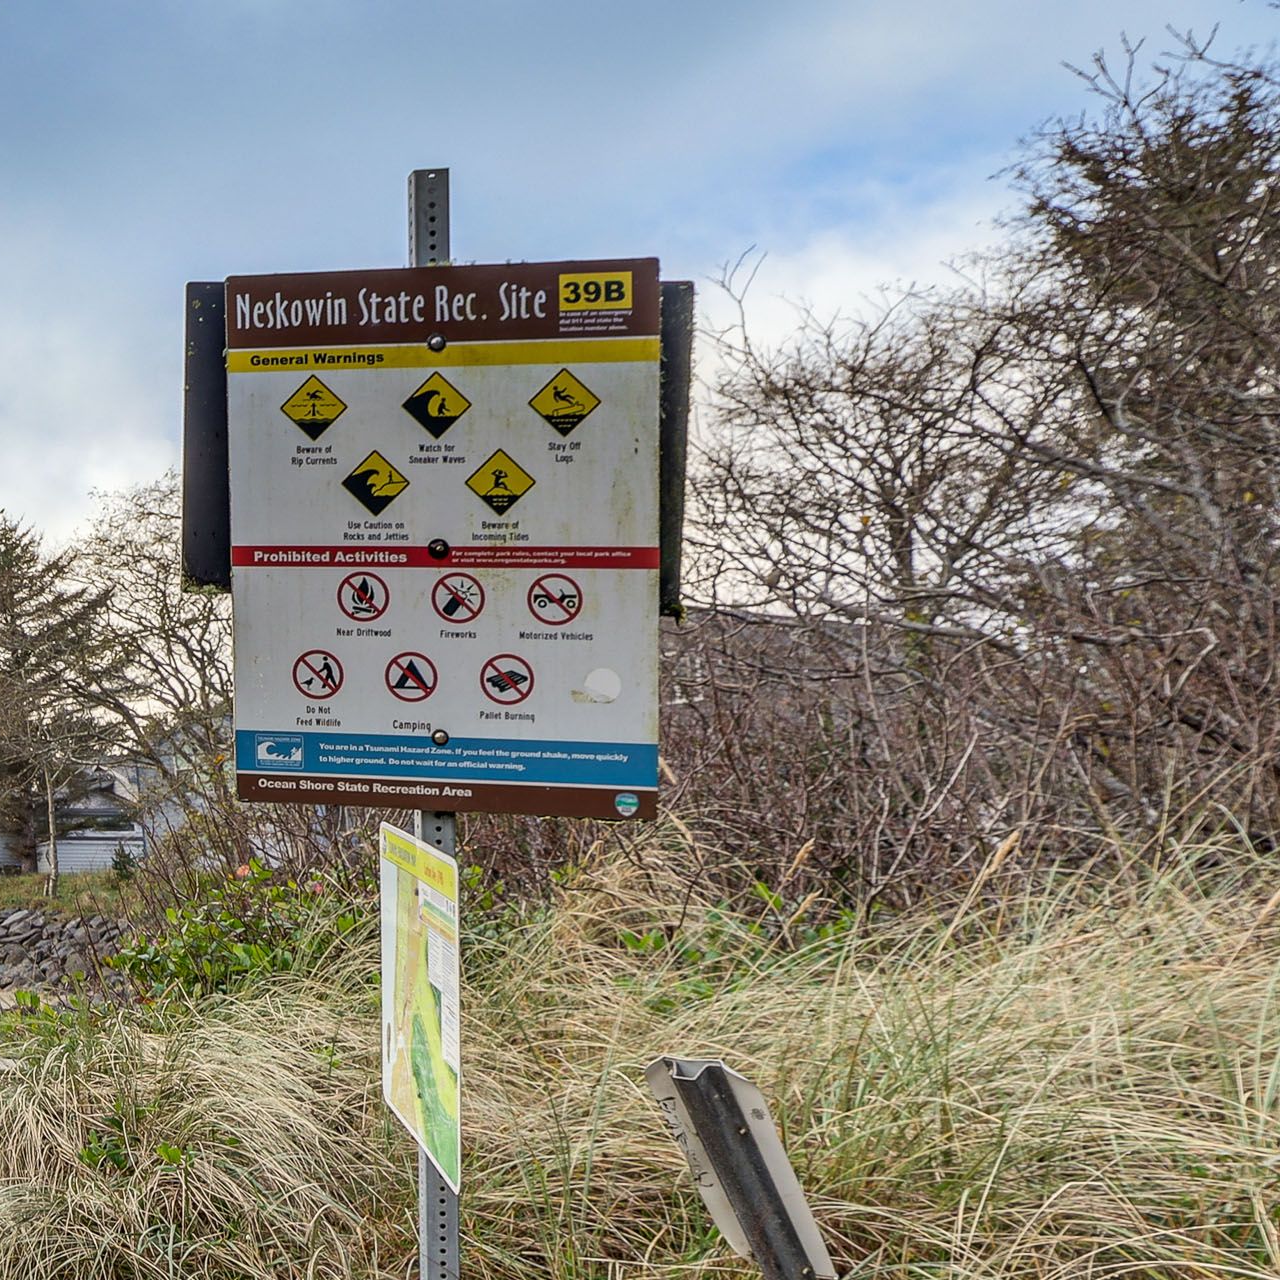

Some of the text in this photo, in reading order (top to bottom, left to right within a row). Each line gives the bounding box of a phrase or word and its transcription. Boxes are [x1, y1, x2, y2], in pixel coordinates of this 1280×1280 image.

[563, 280, 625, 303] 39B
[236, 282, 546, 329] Neskowin State Rec. Site
[250, 352, 384, 366] General Warnings
[296, 445, 332, 454] Beware of
[419, 444, 455, 452] Watch for
[548, 442, 581, 452] Stay Off
[291, 456, 337, 467] Rip Currents
[409, 455, 466, 464] Sneaker Waves
[555, 454, 573, 464] Logs
[347, 521, 360, 529] Use
[364, 521, 392, 529] Caution
[482, 521, 519, 529] Beware of
[343, 532, 409, 541] Rocks and Jetties
[472, 532, 529, 543] Incoming Tides
[254, 551, 408, 563] Prohibited Activities
[336, 628, 391, 637] Near Driftwood
[440, 630, 477, 639] Fireworks
[519, 631, 593, 641] Motorized Vehicles
[306, 705, 331, 714] Do Not
[296, 717, 341, 727] Feed Wildlife
[479, 711, 535, 723] Pallet Burning
[392, 720, 432, 733] Camping
[364, 744, 400, 753] Tsunami
[400, 746, 430, 754] Hazard
[430, 747, 454, 755] Zone.
[462, 749, 478, 757] you
[478, 748, 495, 756] feel
[496, 749, 509, 757] the
[510, 750, 541, 758] ground
[542, 751, 571, 760] shake,
[595, 753, 628, 763] quickly
[328, 755, 354, 764] higher
[355, 757, 386, 766] ground.
[400, 758, 415, 766] not
[434, 759, 446, 767] for
[458, 761, 487, 769] official
[488, 763, 526, 772] warning.
[258, 778, 472, 797] Ocean Shore State Recreation Area
